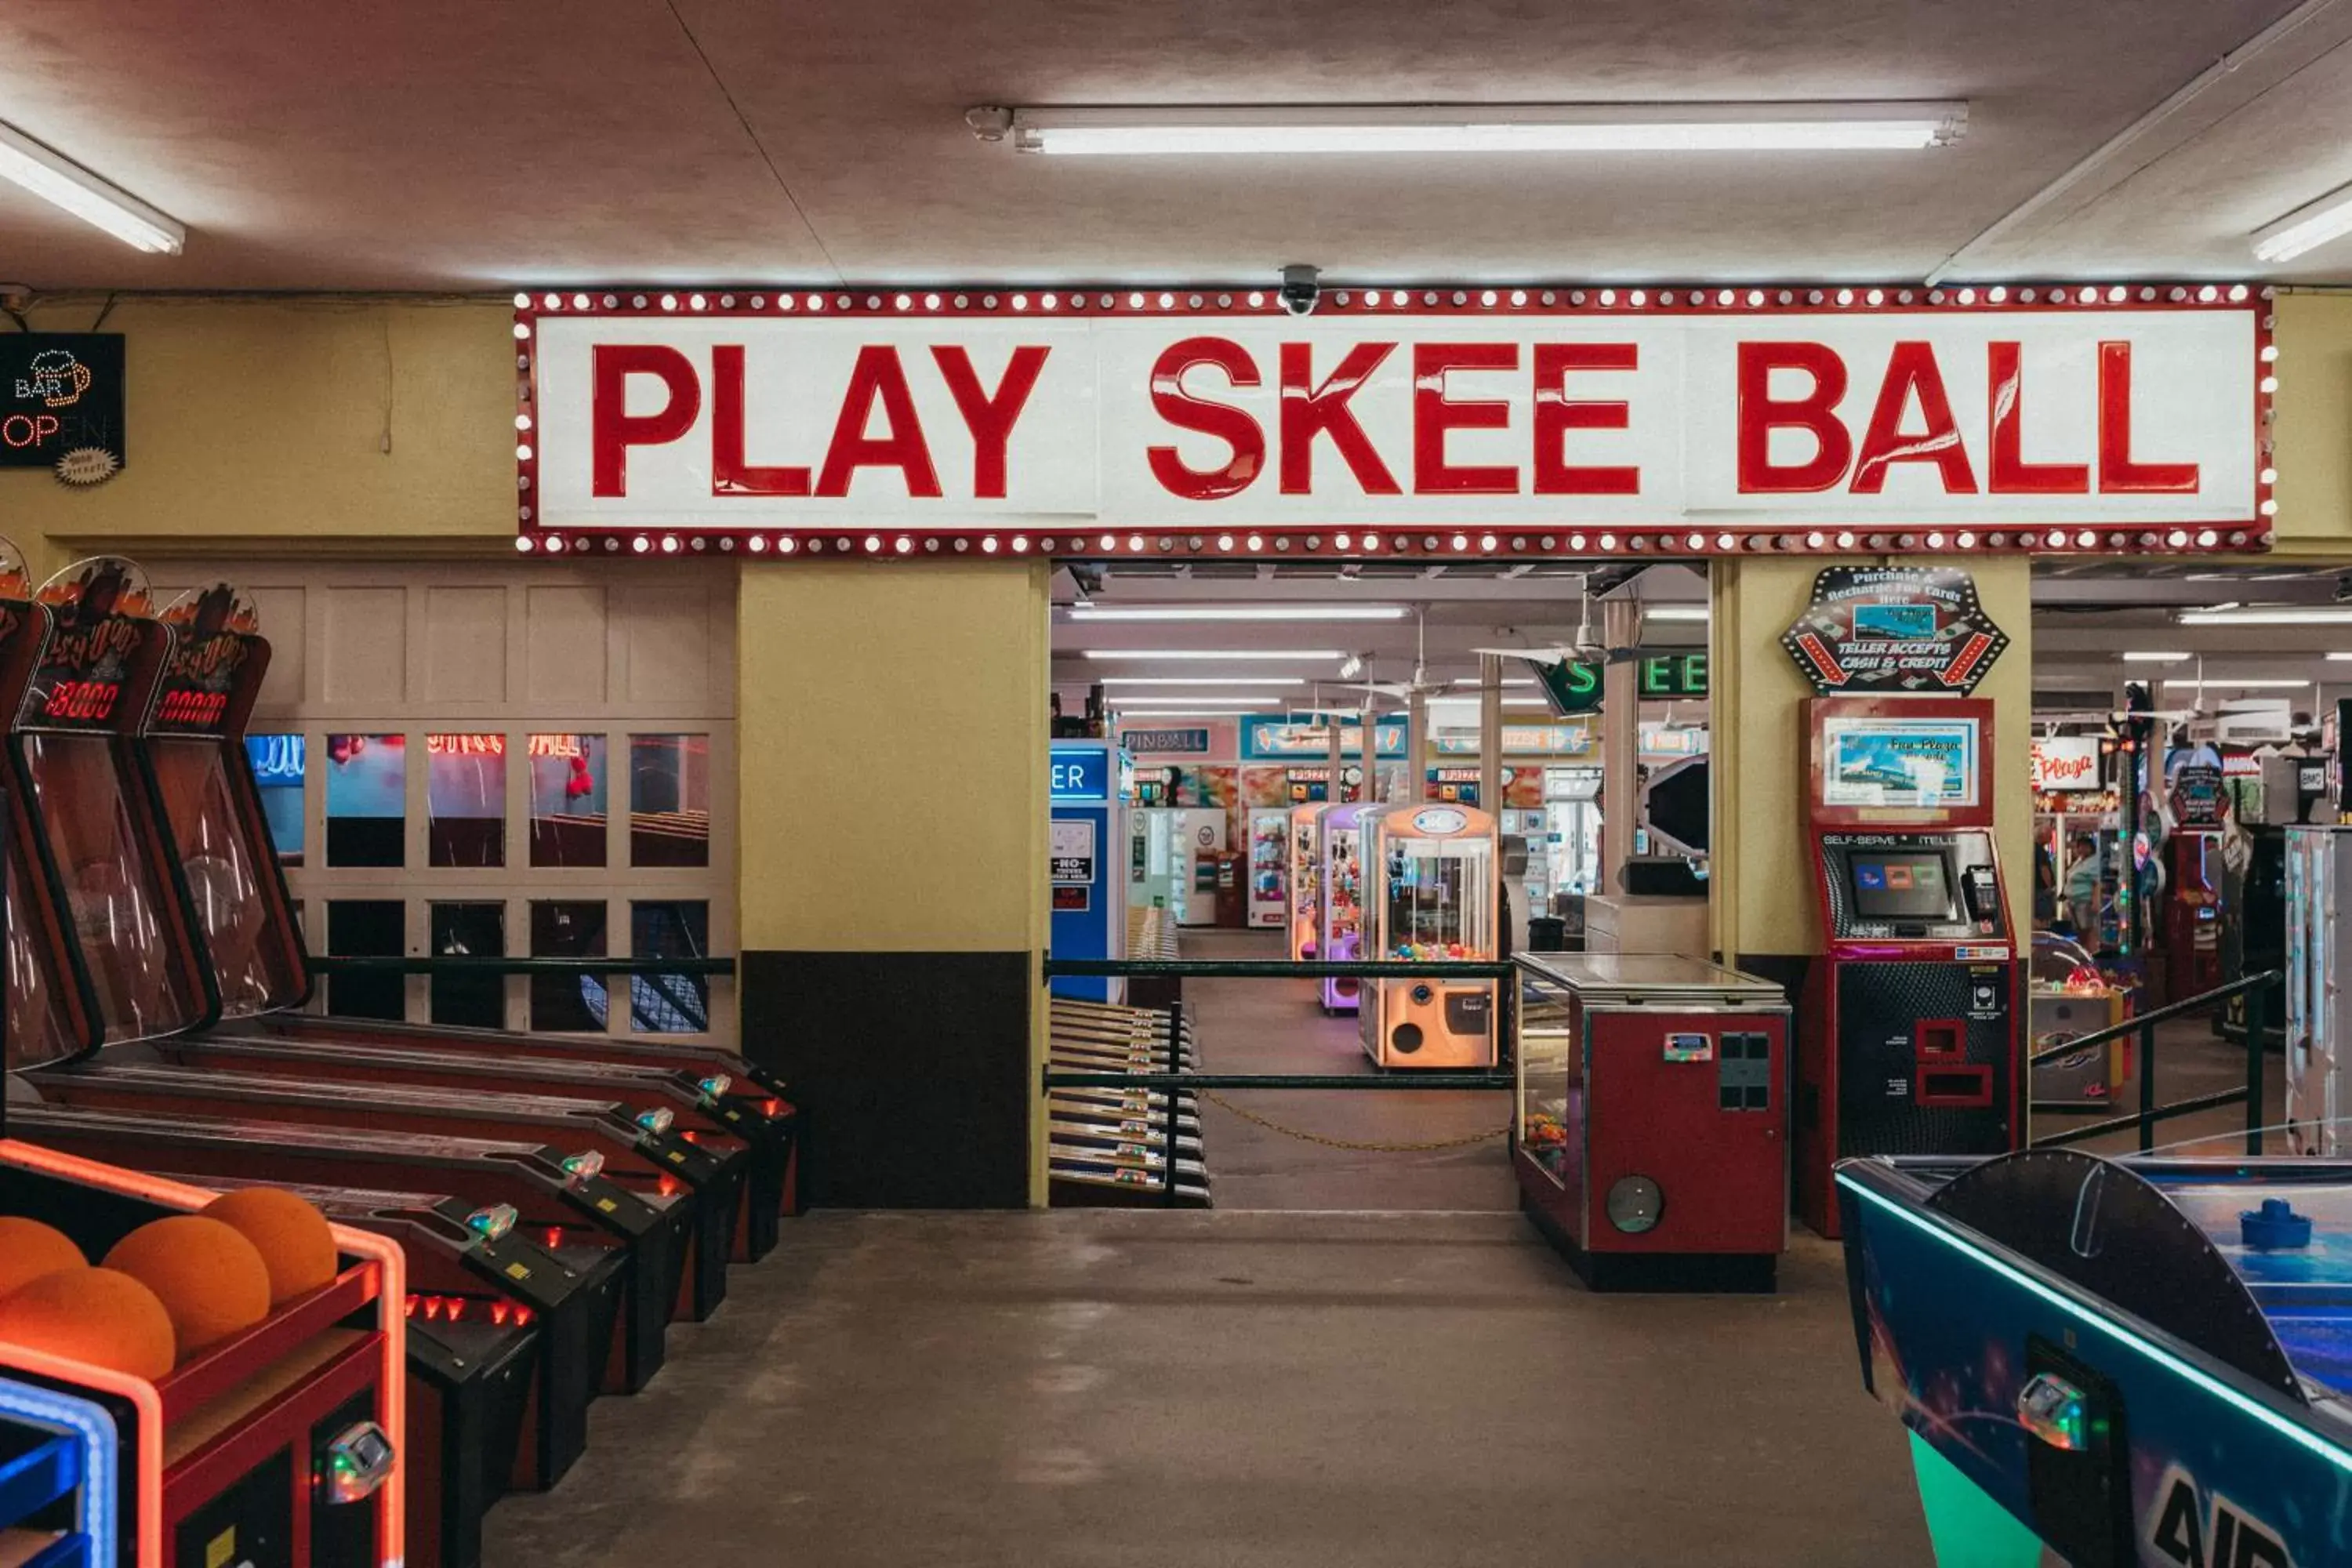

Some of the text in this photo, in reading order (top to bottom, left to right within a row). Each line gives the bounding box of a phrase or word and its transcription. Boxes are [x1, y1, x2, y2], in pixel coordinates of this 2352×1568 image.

[15, 378, 63, 397] BAR
[593, 336, 2200, 500] PLAY SKEE BALL
[1838, 642, 1952, 655] TELLER ACCEPTS
[1840, 656, 1951, 669] CASH & CREDIT
[1125, 732, 1203, 750] PINBALL
[2040, 755, 2093, 781] Plaza
[1823, 835, 1896, 845] SELF-SERVE
